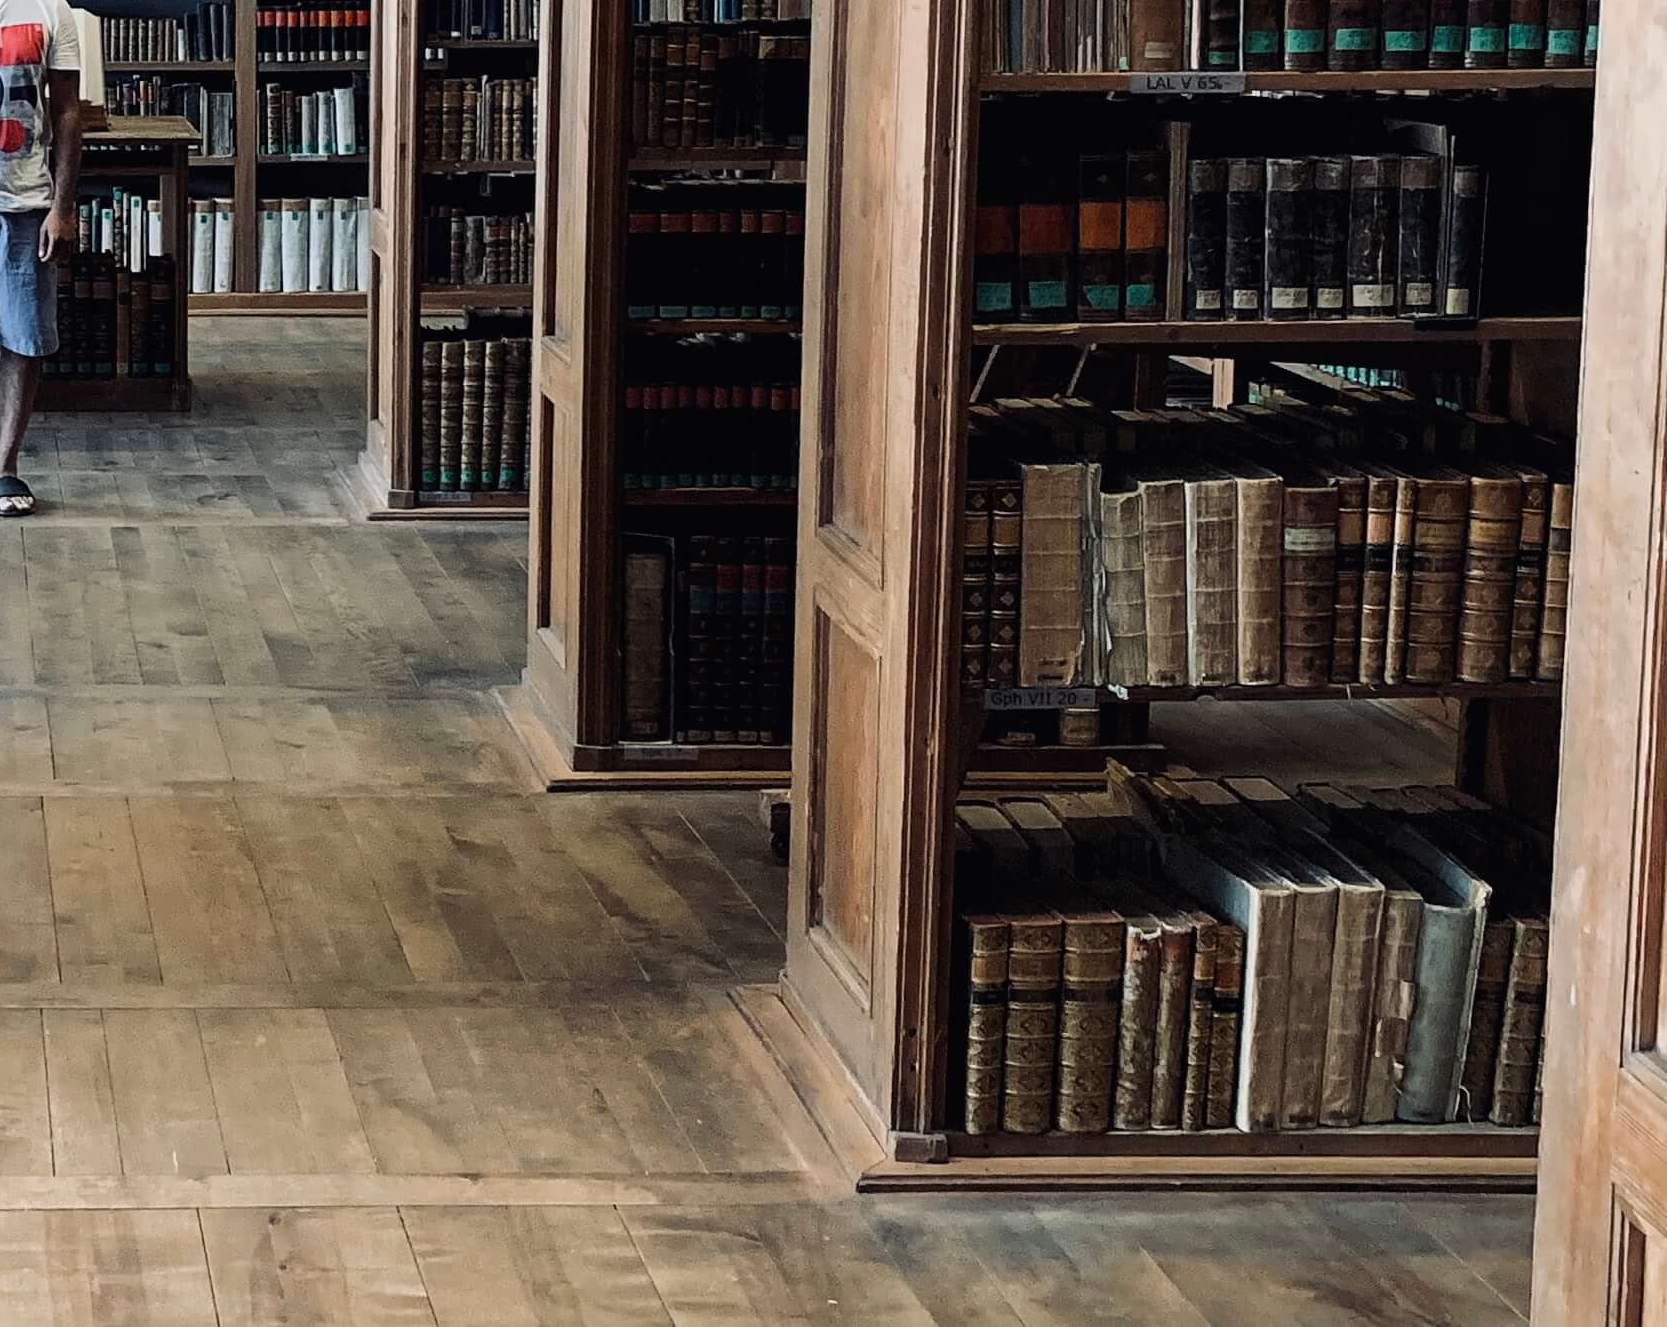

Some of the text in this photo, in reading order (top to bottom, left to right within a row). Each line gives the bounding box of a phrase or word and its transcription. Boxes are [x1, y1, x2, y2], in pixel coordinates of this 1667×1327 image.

[1147, 76, 1176, 90] LAL
[1181, 76, 1193, 89] V
[991, 693, 1023, 707] Gph
[1028, 692, 1052, 705] VII
[1058, 693, 1077, 705] 20
